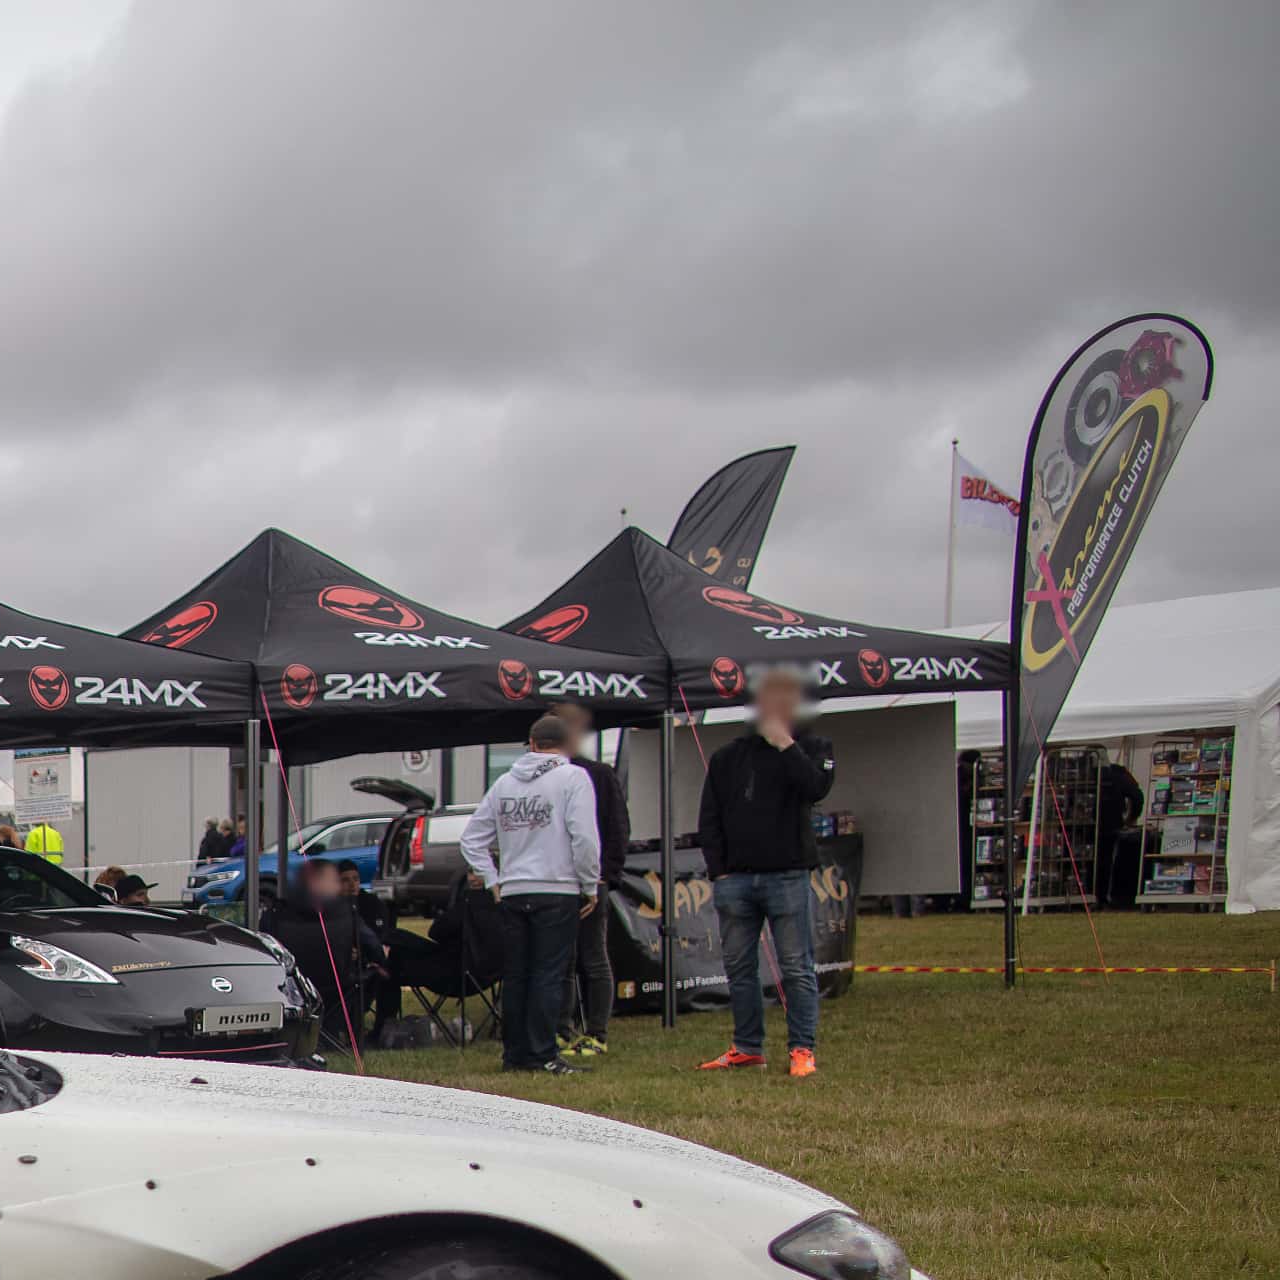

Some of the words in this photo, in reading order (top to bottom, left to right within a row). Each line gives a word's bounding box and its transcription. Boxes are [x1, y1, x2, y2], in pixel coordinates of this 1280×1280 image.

[1067, 505, 1124, 618] PERFORMANCE
[1118, 438, 1153, 505] CLUTCH
[353, 632, 490, 649] 24MX
[890, 657, 983, 681] 24MX
[74, 677, 207, 708] 24MX
[323, 671, 447, 700] 24MX
[538, 670, 648, 699] 24MX
[218, 1013, 271, 1025] nismo
